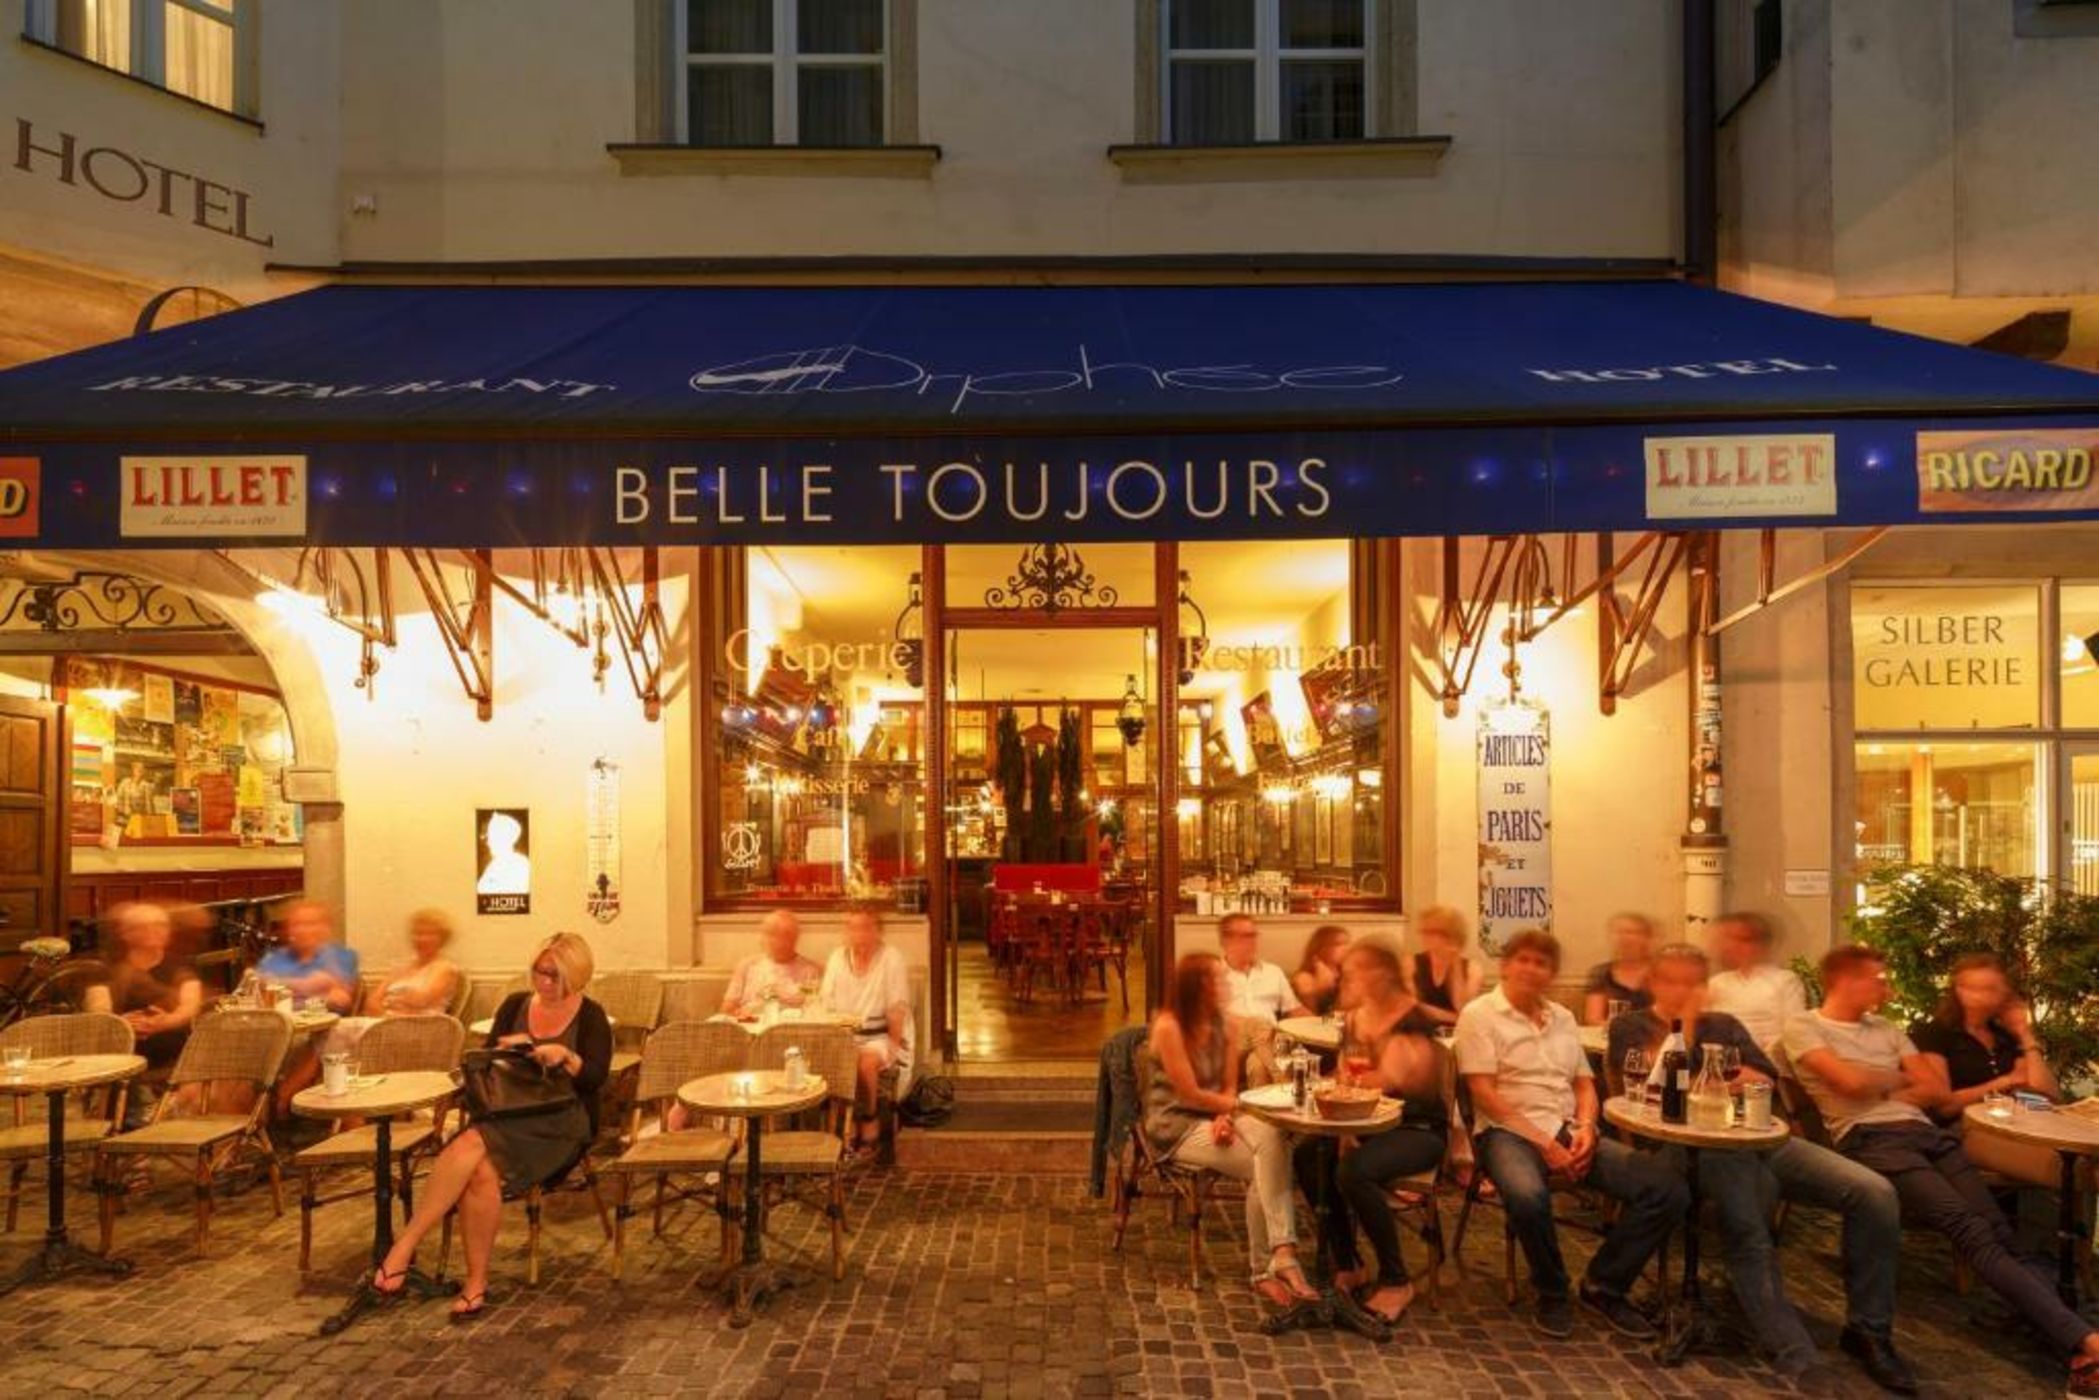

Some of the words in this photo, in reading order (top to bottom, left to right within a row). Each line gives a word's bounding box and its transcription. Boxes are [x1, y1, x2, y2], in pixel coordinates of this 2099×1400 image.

[12, 117, 274, 248] HOTEL
[1525, 358, 1838, 381] HOTEL
[85, 376, 618, 398] RESTAURANT
[1656, 445, 1823, 489] LILLET
[1927, 447, 2091, 491] RICARD
[131, 465, 295, 507] LILLET
[614, 465, 833, 525] BELLE
[879, 457, 1331, 523] TOUJOURS
[1881, 615, 2005, 645] SILBER
[1185, 638, 1383, 672] Restauant
[1865, 657, 2022, 688] GALERIE
[1483, 734, 1545, 767] ARTICLES
[1503, 782, 1526, 795] DE
[1487, 810, 1543, 842] PARIS
[1505, 858, 1526, 870] ET
[1485, 886, 1547, 919] JOUETS
